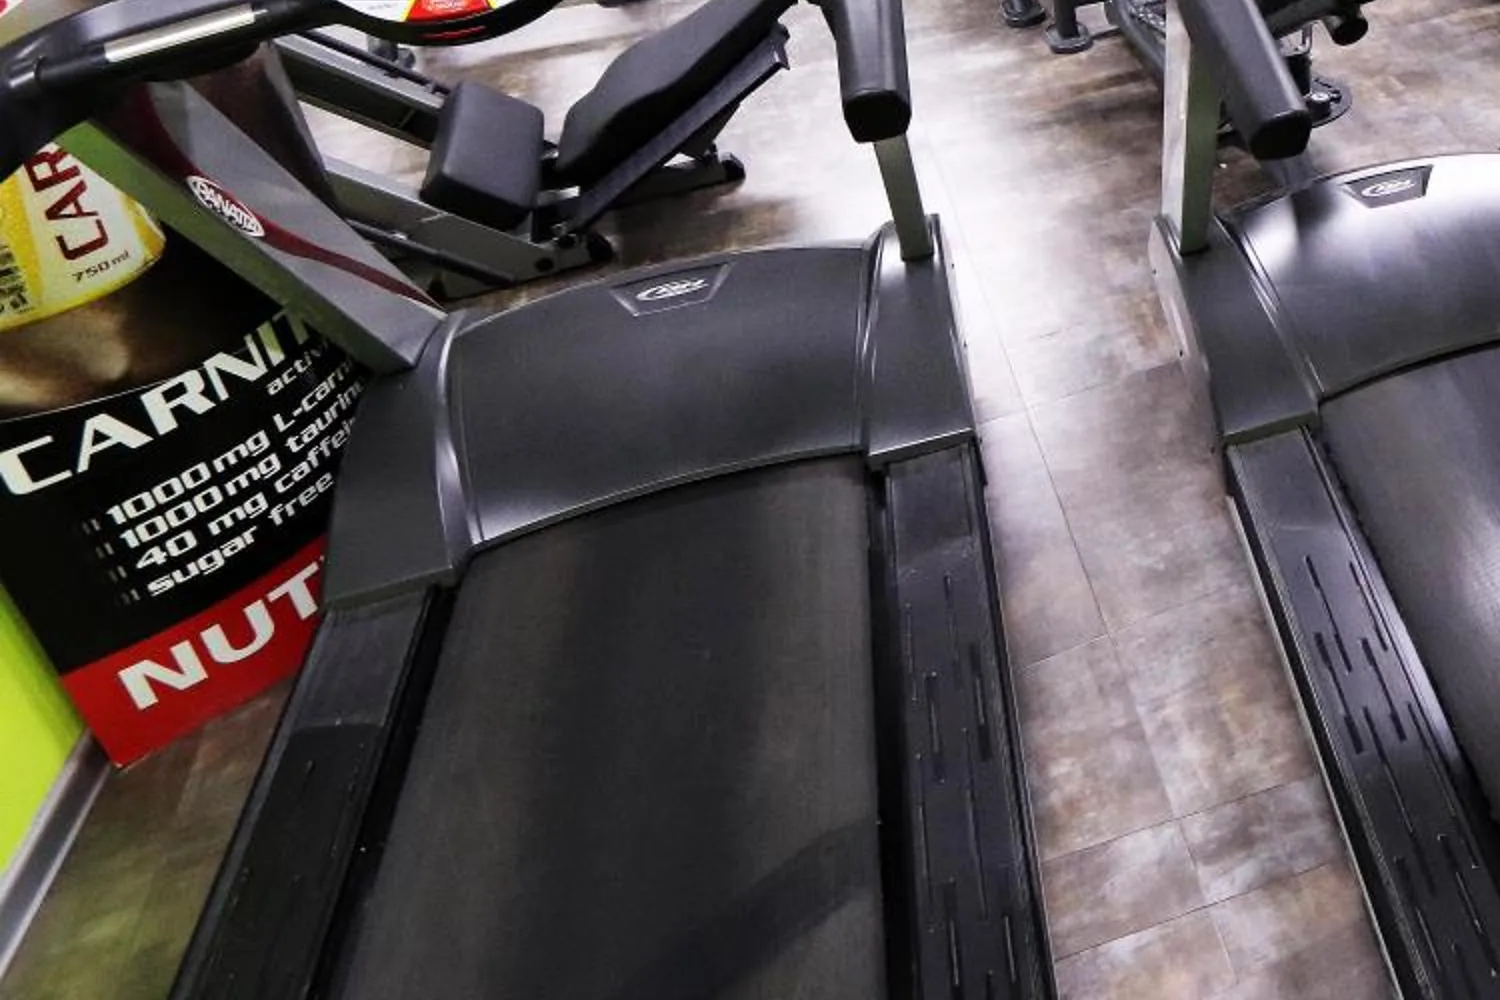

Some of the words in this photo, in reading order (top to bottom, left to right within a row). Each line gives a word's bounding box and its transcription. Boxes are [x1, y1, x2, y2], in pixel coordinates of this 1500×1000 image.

[72, 260, 110, 283] 750
[106, 461, 211, 525] 1000
[213, 429, 270, 473] mg
[120, 485, 224, 549] 1000
[225, 452, 282, 496] mg
[136, 529, 198, 569] 40
[207, 491, 269, 536] mg
[147, 525, 258, 597] sugar
[268, 471, 335, 526] free
[117, 556, 324, 711] NUT
